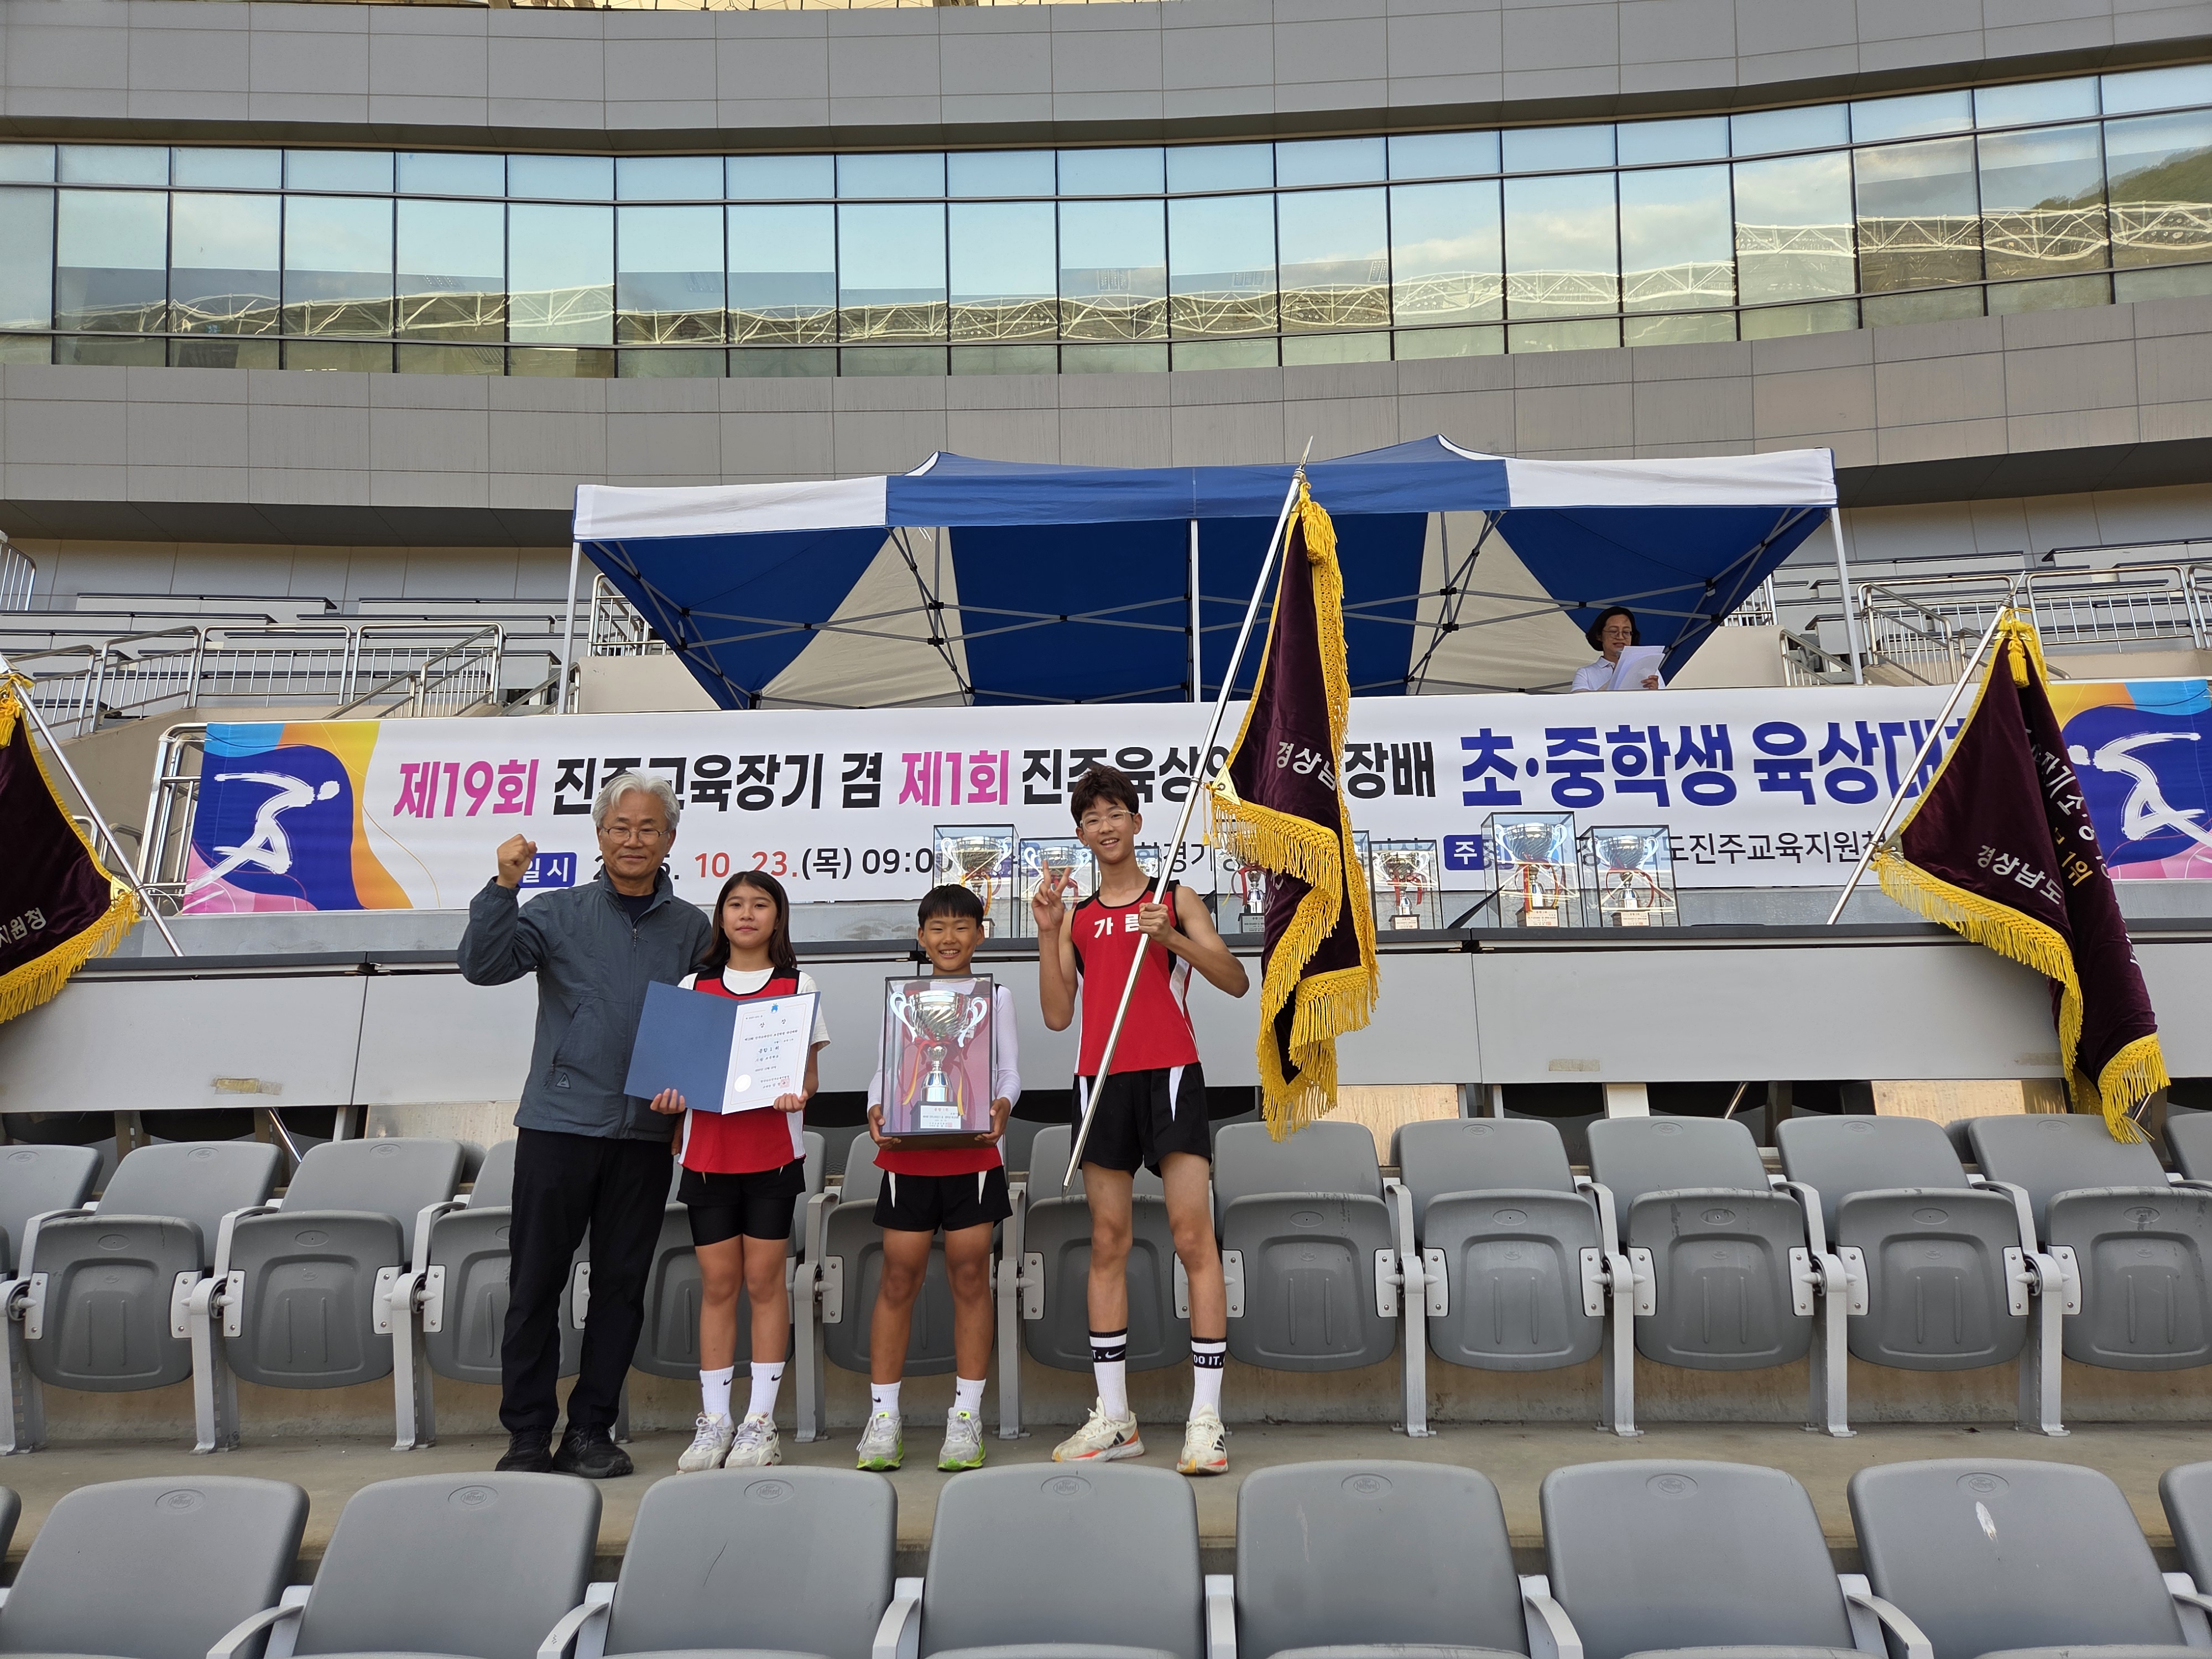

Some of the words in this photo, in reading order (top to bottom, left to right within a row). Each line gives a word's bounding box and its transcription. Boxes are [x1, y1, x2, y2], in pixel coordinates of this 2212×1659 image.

[393, 759, 539, 818] 제19회
[842, 752, 883, 808] 겸
[899, 750, 1010, 807] 제1회
[1460, 724, 1737, 808] 초·중학생
[1752, 718, 1967, 805] 육상대
[1978, 845, 2063, 905] 경상남도
[1193, 1354, 1206, 1365] DO
[1208, 1355, 1222, 1366] IT.
